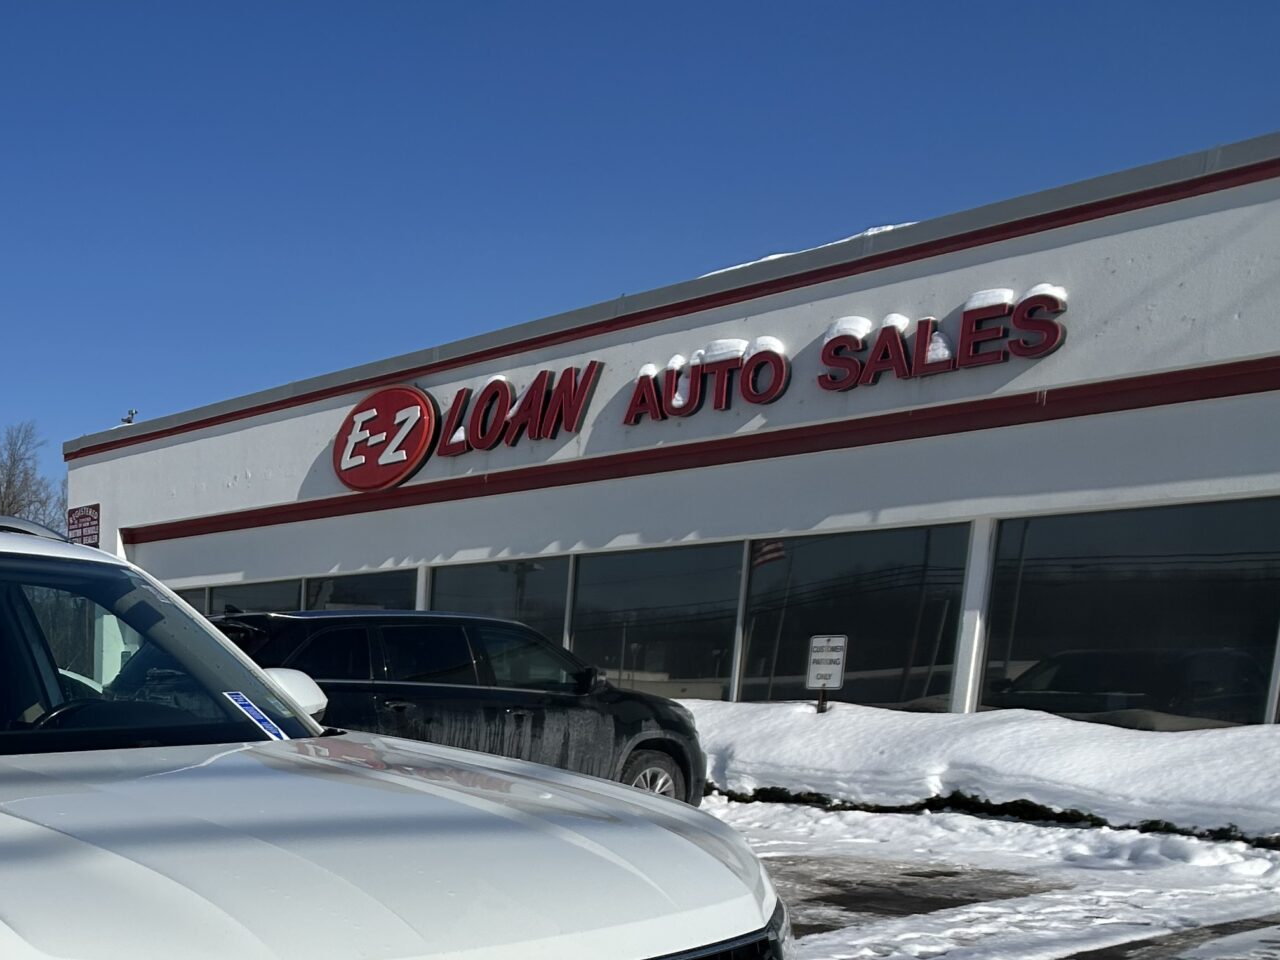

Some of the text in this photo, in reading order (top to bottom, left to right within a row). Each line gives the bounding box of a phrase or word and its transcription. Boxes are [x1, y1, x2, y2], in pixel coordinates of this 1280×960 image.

[339, 293, 1067, 471] E-Z LOAN AUTO SALES
[812, 658, 841, 666] PARKING
